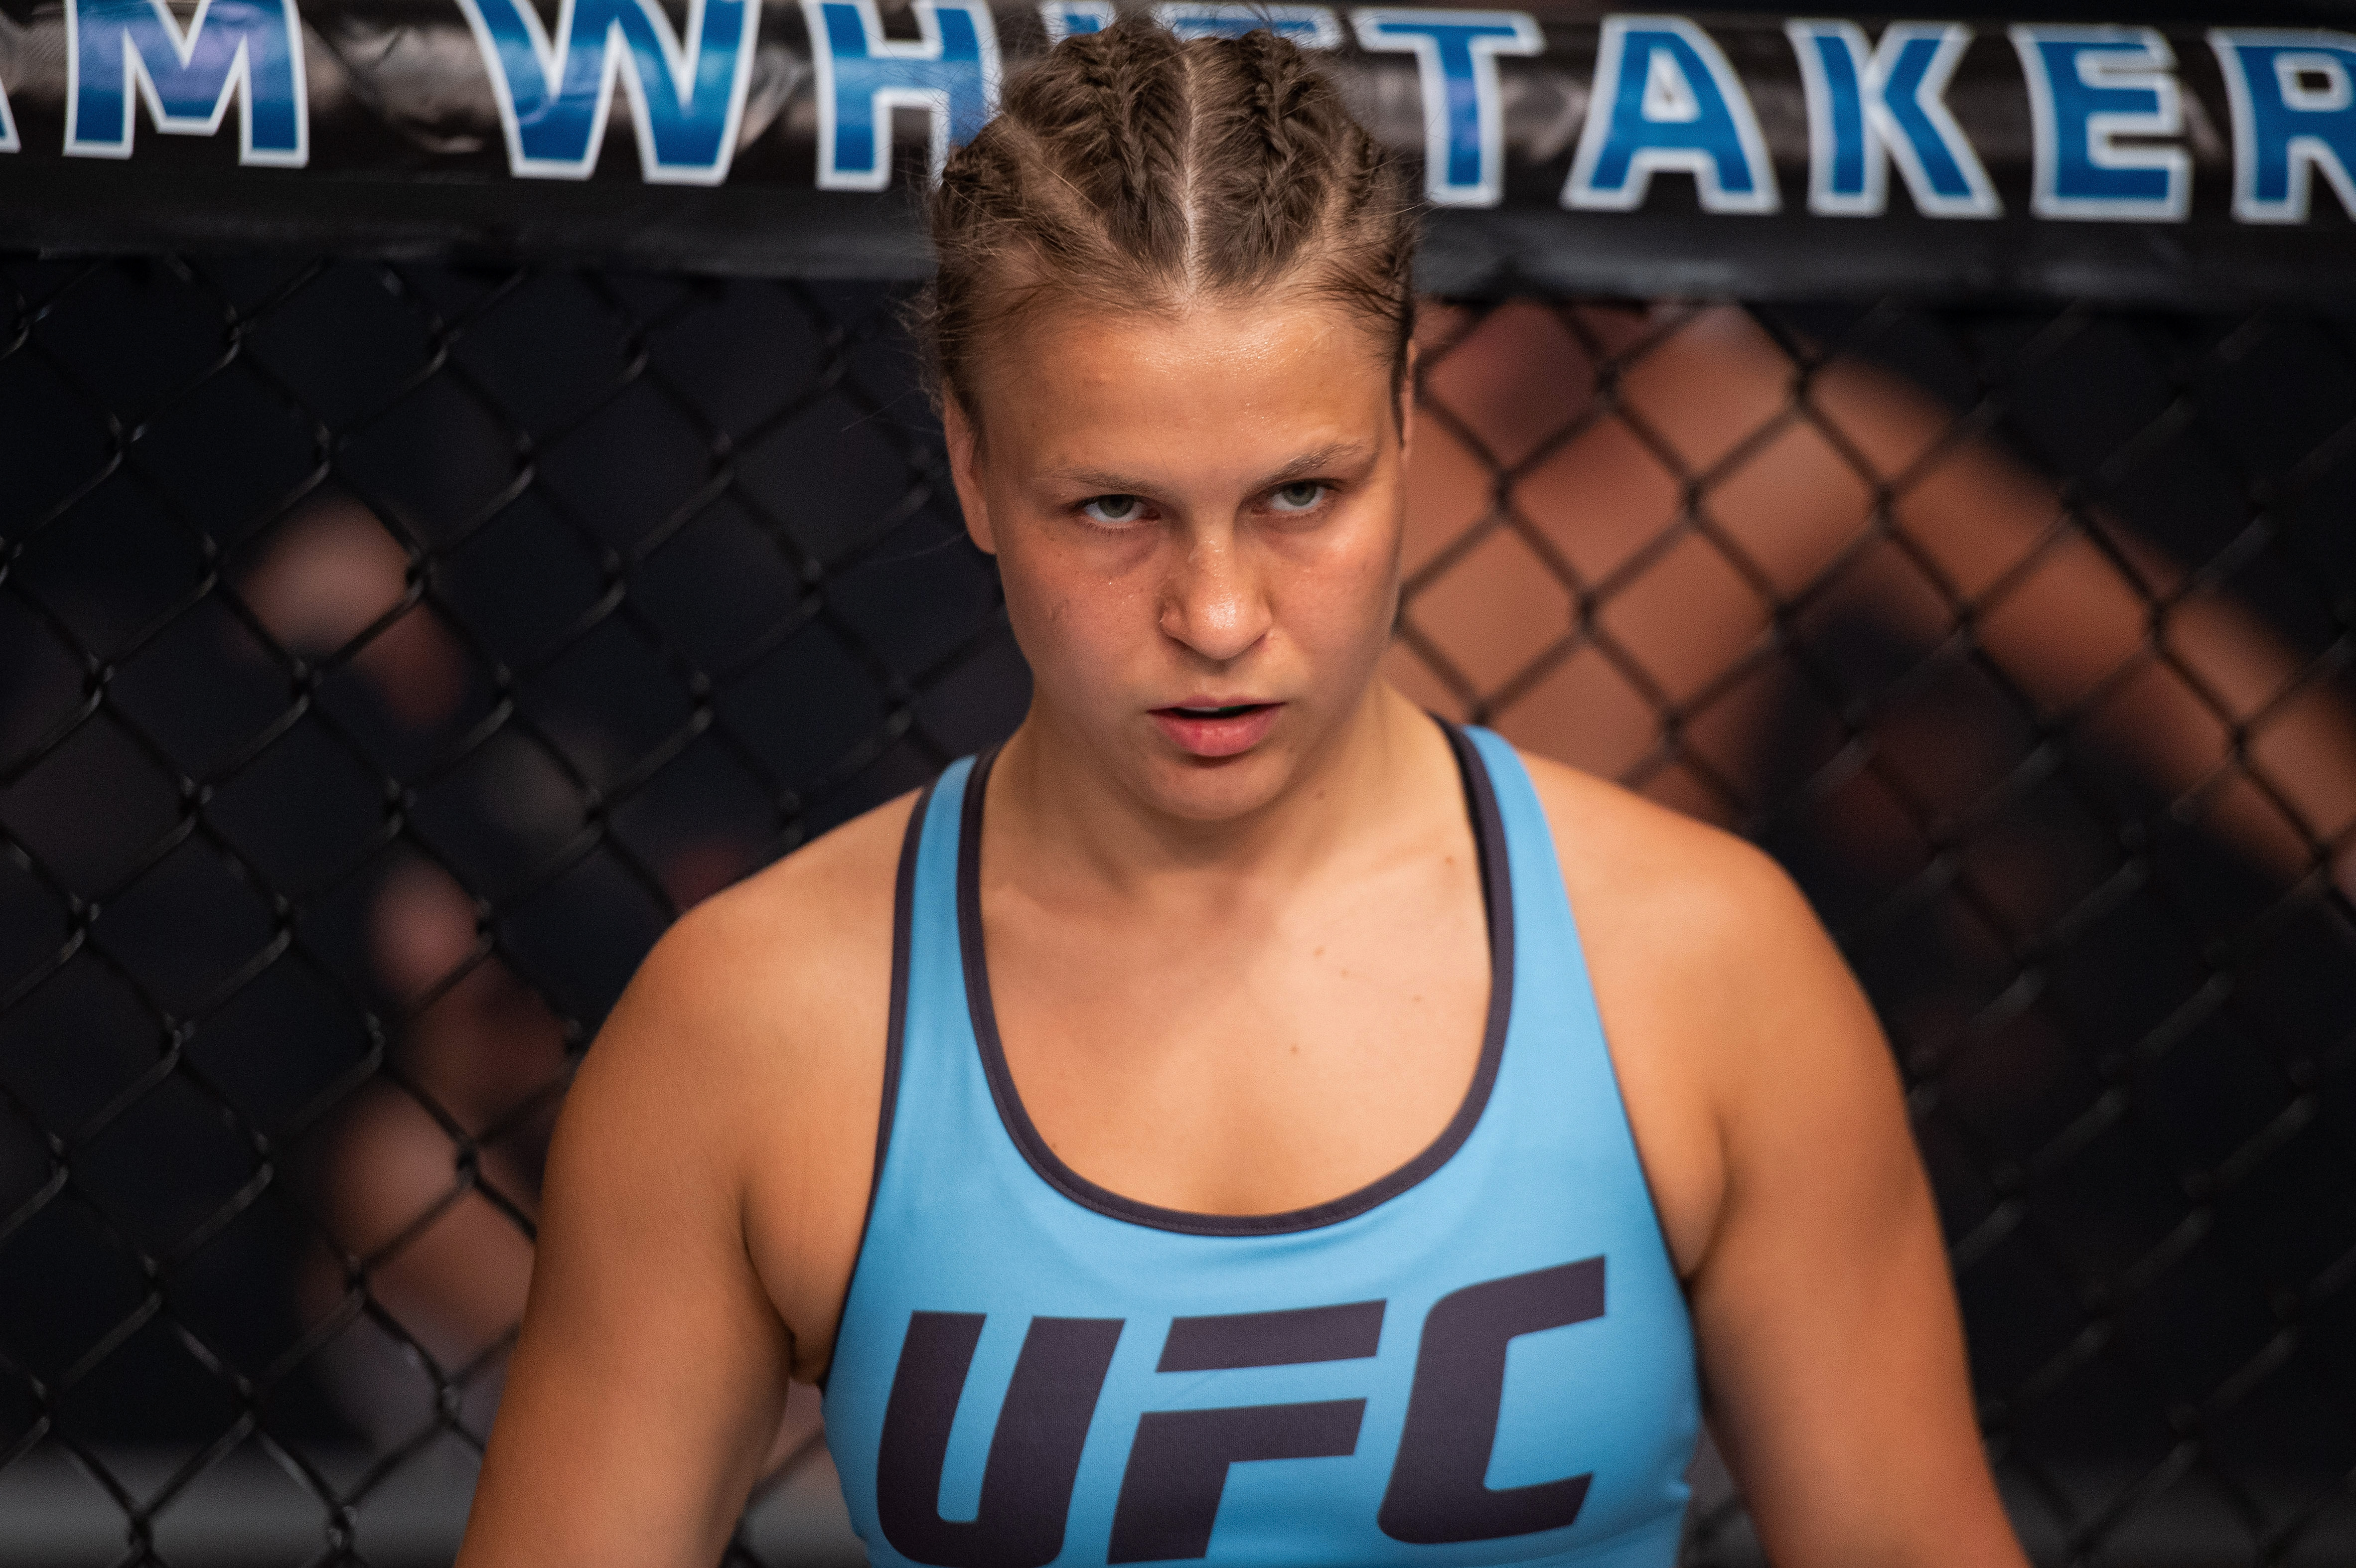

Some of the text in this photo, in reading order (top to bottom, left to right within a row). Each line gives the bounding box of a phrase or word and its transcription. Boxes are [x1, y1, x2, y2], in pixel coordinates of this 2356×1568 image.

[0, 0, 2356, 225] M WHTAKER
[877, 1254, 1606, 1568] UFC
